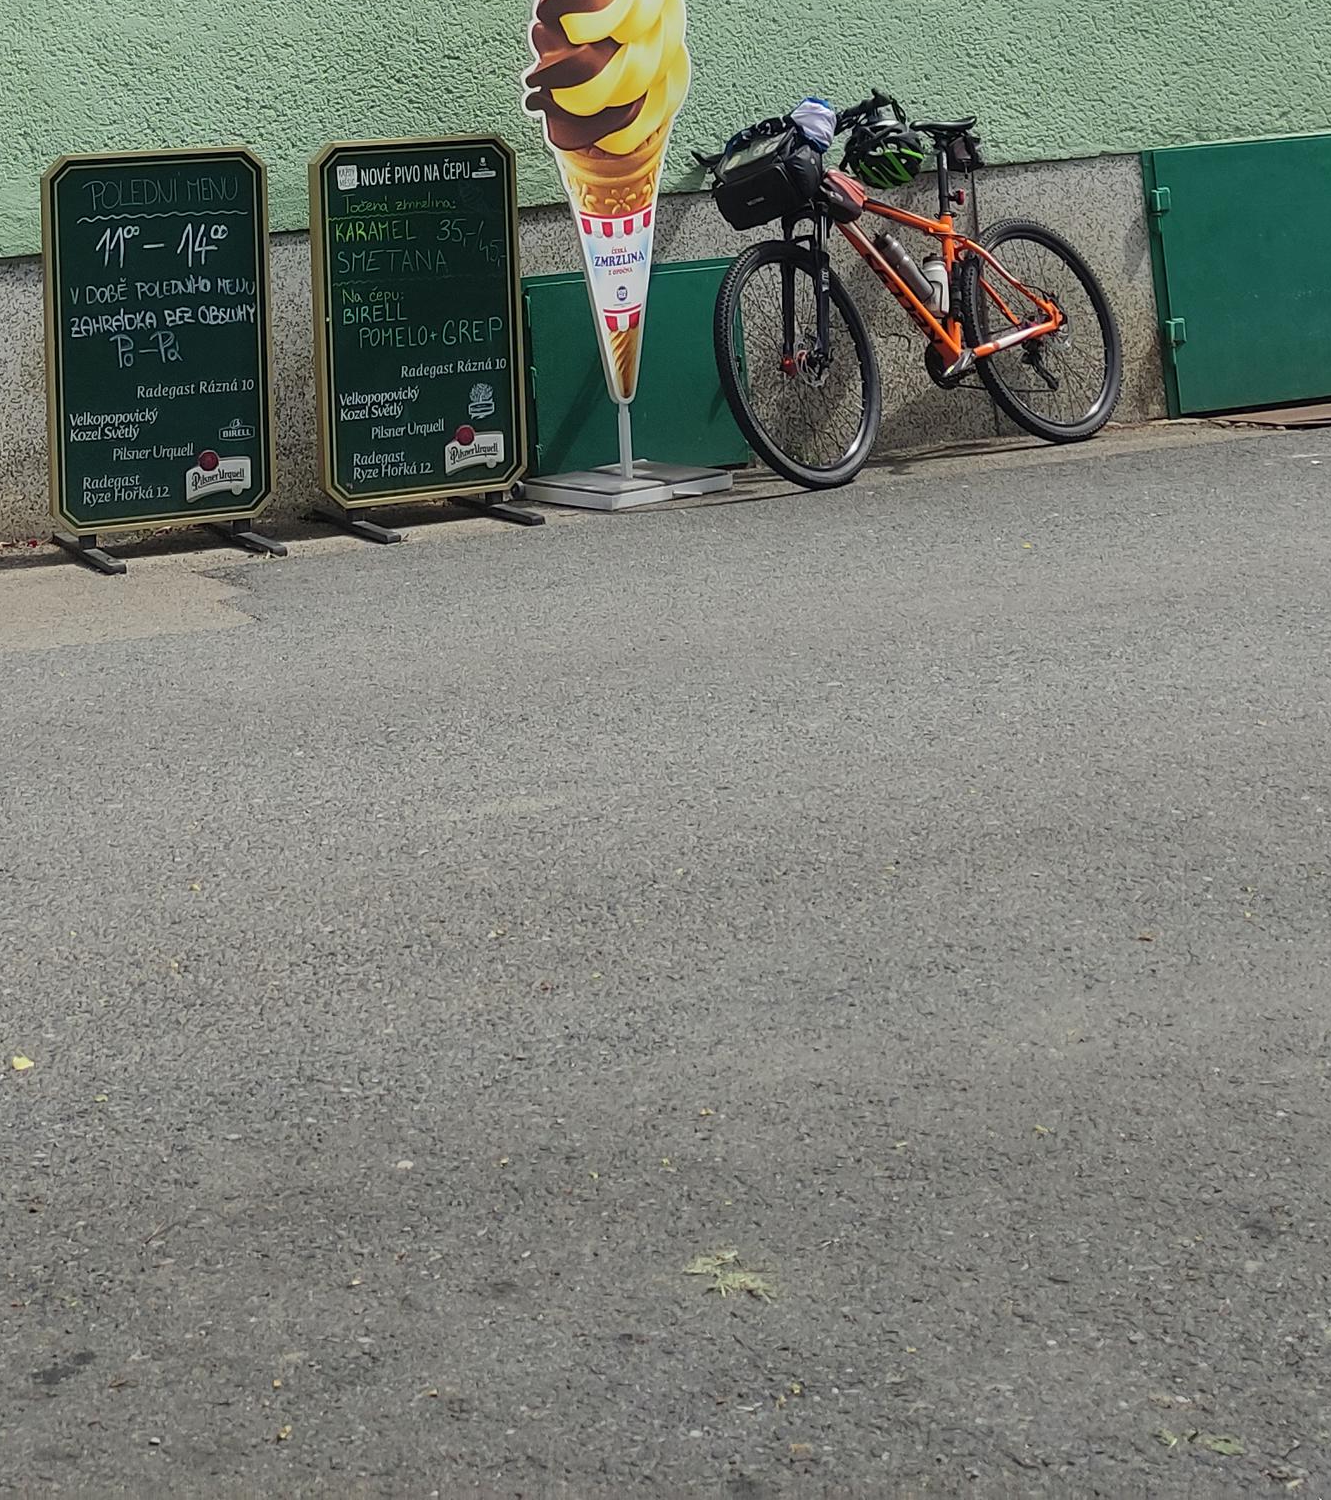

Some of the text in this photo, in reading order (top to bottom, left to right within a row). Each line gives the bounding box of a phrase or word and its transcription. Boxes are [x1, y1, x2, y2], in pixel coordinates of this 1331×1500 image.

[360, 158, 470, 186] NOVÉ PIVO NA ČEPU
[82, 172, 239, 211] POLEDNÍ MENU
[341, 194, 388, 214] Točená
[335, 219, 418, 243] KARAMEL
[337, 250, 447, 274] SMETANA
[594, 250, 645, 267] ZMRZLINA
[70, 274, 255, 305] V DOBĚ POLEDNÍHO MENU
[342, 289, 363, 304] Na
[70, 303, 256, 338] ZAHRÁDKA BEZ OBSLUHY
[342, 303, 409, 326] BIRELL
[400, 357, 507, 379] Radegast Rázná 10
[136, 378, 255, 400] Radegast Rázná 10
[339, 384, 420, 406] Velkopopovický
[69, 407, 159, 428] Velkopopovický
[340, 400, 404, 422] Kozel Světlý
[70, 424, 140, 443] Kozel Světlý
[371, 418, 445, 440] Pilsner Urquell
[112, 442, 195, 462] Pilsner Urquell
[353, 451, 405, 466] Radegast
[449, 442, 499, 465] Pilsner Urquell
[83, 474, 140, 490] Radegast
[191, 467, 245, 492] Pilsner Urquell
[353, 461, 434, 482] Ryze Hořká 12
[83, 485, 171, 507] Ryze Hořká 12
